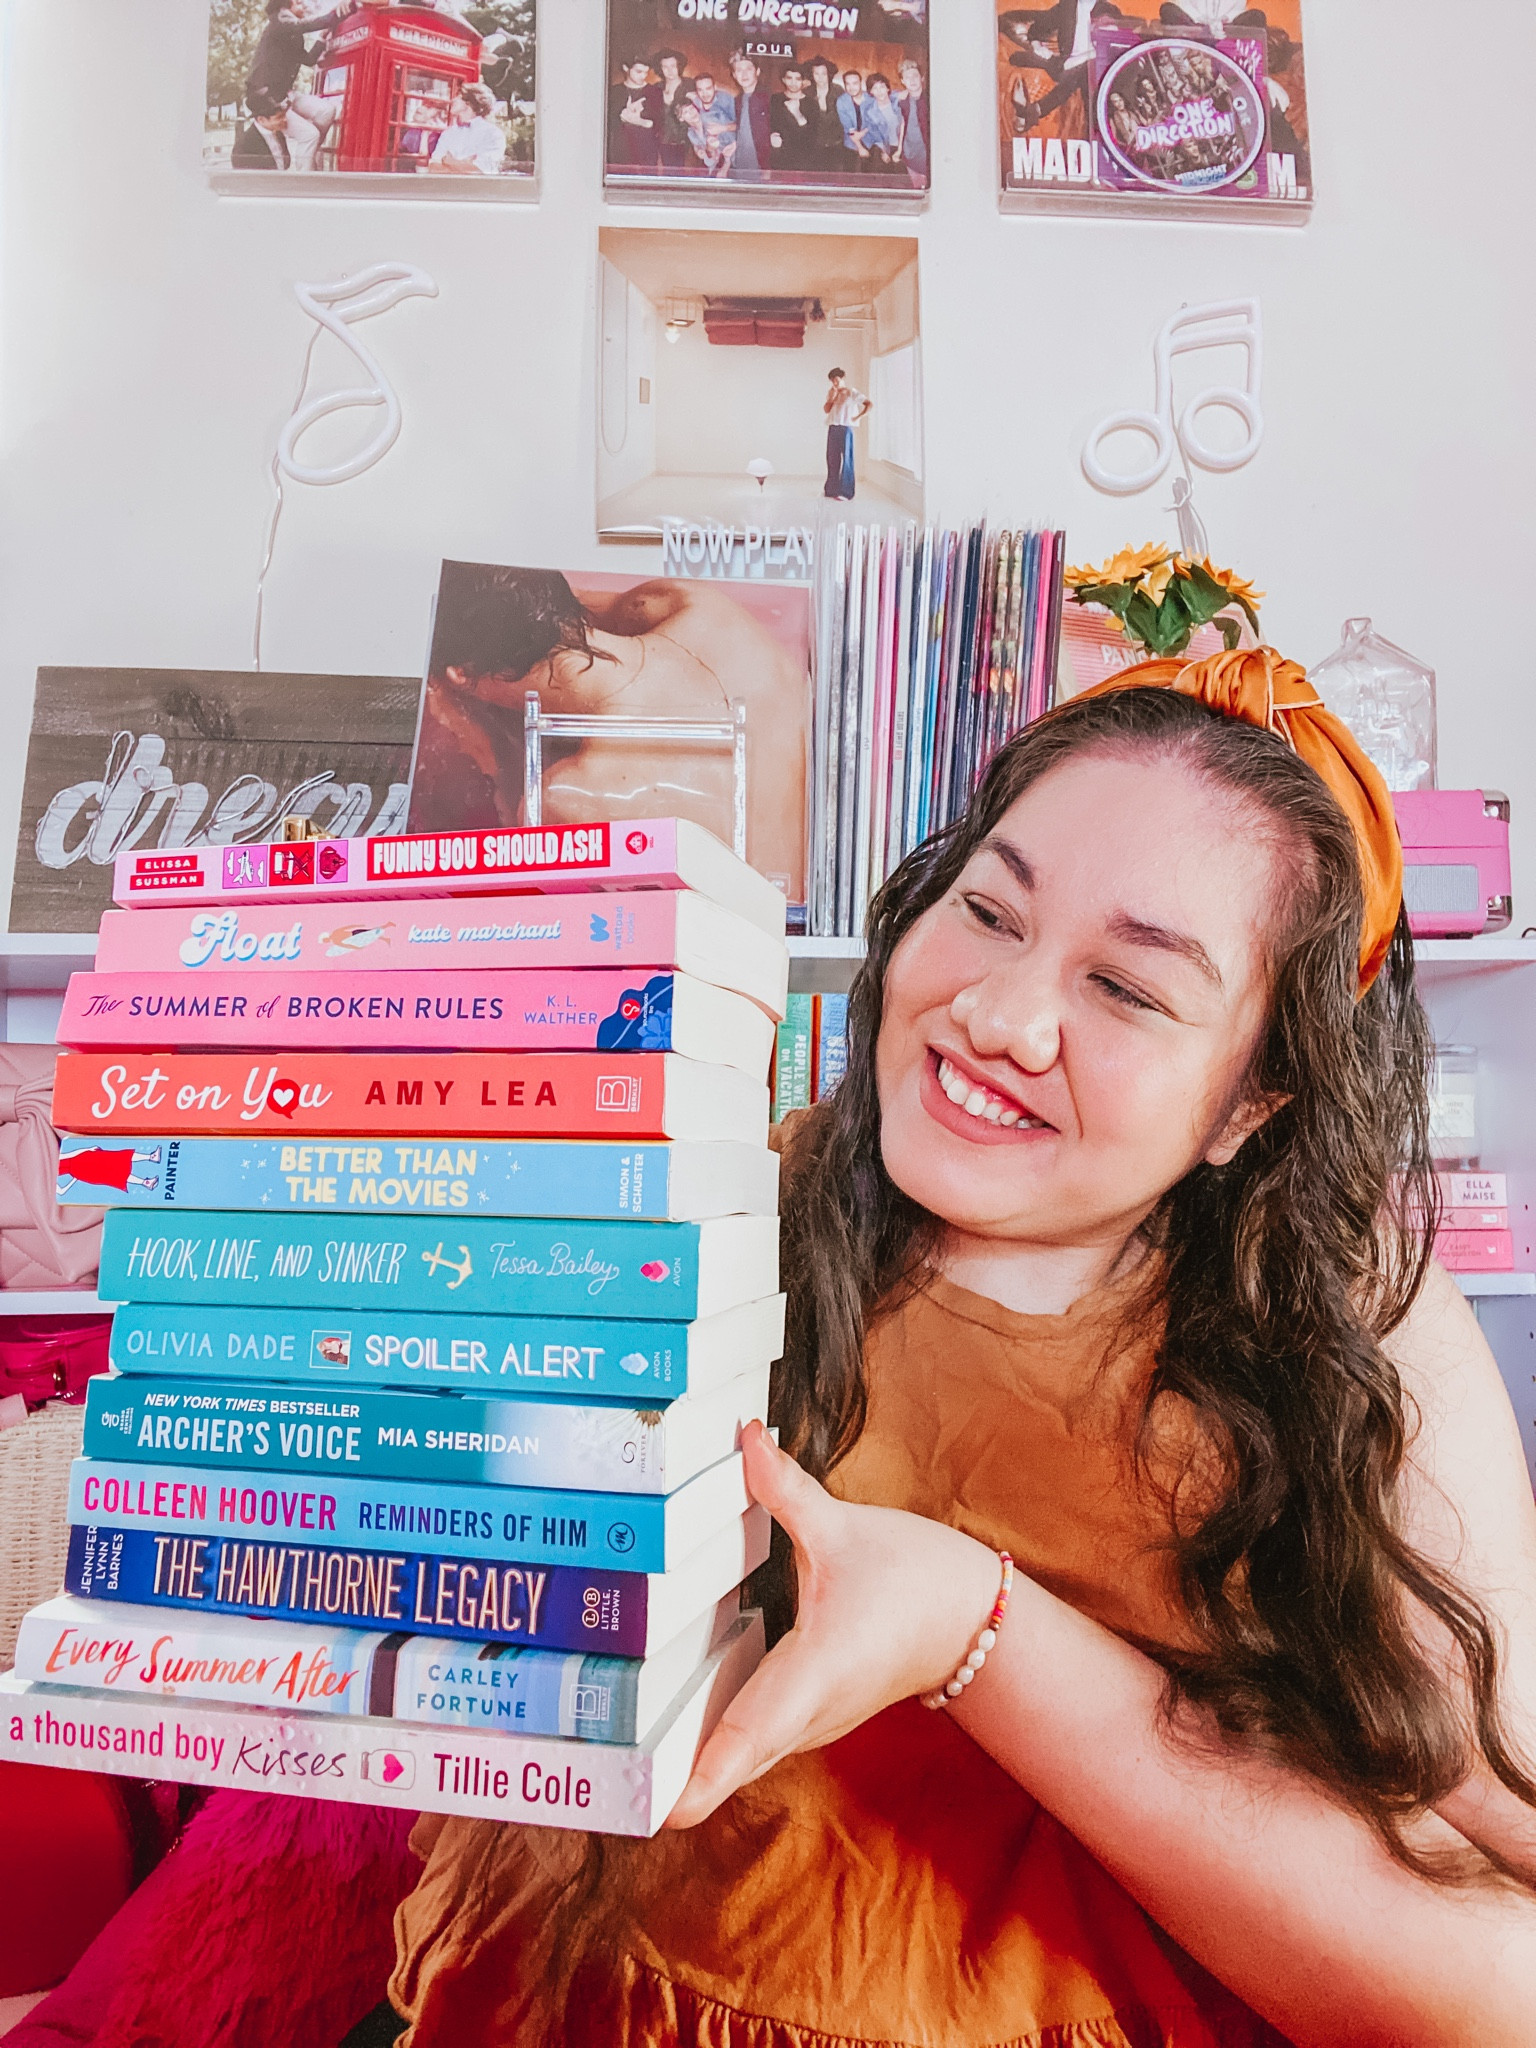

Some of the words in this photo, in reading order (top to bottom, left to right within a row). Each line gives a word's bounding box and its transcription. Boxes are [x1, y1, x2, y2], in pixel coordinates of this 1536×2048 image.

[677, 0, 728, 20] ONE
[738, 0, 859, 32] DIRECTION
[746, 43, 793, 55] FOUR
[1173, 98, 1214, 124] ONE
[1136, 112, 1234, 149] DIRECTION
[1012, 137, 1098, 184] MAD
[662, 522, 735, 563] NOW
[36, 730, 408, 869] drea
[144, 858, 191, 870] ELISSA
[373, 838, 435, 875] FUNNY
[439, 836, 478, 872] YOU
[483, 830, 558, 868] SHOULD
[561, 828, 603, 862] ASK
[135, 874, 198, 887] SUSSMAN
[179, 910, 303, 967] Float
[408, 923, 452, 943] kate
[457, 919, 561, 942] marchant
[81, 994, 125, 1017] The
[128, 995, 248, 1018] SUMMER
[255, 995, 282, 1019] of
[287, 996, 404, 1020] BROKEN
[414, 997, 504, 1021] RULES
[523, 1011, 599, 1025] WALTHER
[546, 995, 561, 1008] K.
[566, 995, 577, 1008] L.
[793, 1034, 807, 1079] PEOPLE
[91, 1064, 170, 1119] Set
[176, 1084, 231, 1110] on
[364, 1080, 455, 1106] AMY
[480, 1081, 558, 1106] LEA
[630, 1077, 638, 1112] BERKLEY
[164, 1141, 180, 1201] PAINTER
[279, 1146, 382, 1174] BETTER
[395, 1148, 477, 1175] THAN
[621, 1156, 630, 1166] &
[285, 1176, 337, 1203] THE
[348, 1178, 469, 1207] MOVIES
[619, 1173, 630, 1209] SIMON
[632, 1153, 644, 1213] SCHUSTER
[1462, 1192, 1496, 1201] MAISE
[1465, 1180, 1492, 1189] ELLA
[126, 1237, 201, 1281] HOOK,
[203, 1239, 261, 1283] LINE,
[269, 1245, 313, 1277] AND
[318, 1241, 407, 1284] SINKER
[490, 1240, 545, 1279] Tessa
[545, 1242, 620, 1296] Bailey
[673, 1257, 681, 1286] AVON
[127, 1330, 214, 1358] OLIVIA
[227, 1334, 295, 1361] DADE
[365, 1335, 491, 1374] SPOILER
[500, 1343, 604, 1380] ALERT
[653, 1351, 661, 1379] AVON
[664, 1349, 672, 1382] BOOKS
[144, 1393, 180, 1407] NEW
[183, 1395, 220, 1410] YORK
[225, 1398, 266, 1412] TIMES
[270, 1400, 360, 1418] BESTSELLER
[279, 1423, 361, 1461] VOICE
[377, 1427, 418, 1448] MIA
[424, 1430, 539, 1455] SHERIDAN
[84, 1476, 207, 1520] COLLEEN
[218, 1487, 336, 1531] HOOVER
[359, 1502, 493, 1540] REMINDERS
[503, 1514, 532, 1542] OF
[542, 1517, 587, 1547] HIM
[80, 1525, 98, 1594] JENNIFER
[95, 1541, 109, 1580] LYNN
[107, 1533, 124, 1590] BARNES
[153, 1537, 209, 1599] THE
[216, 1543, 406, 1621] HAWTHORNE
[414, 1561, 547, 1635] LEGACY
[611, 1590, 620, 1631] BROWN
[45, 1628, 140, 1684] Every
[139, 1635, 281, 1684] Summer
[272, 1645, 360, 1703] After
[428, 1664, 519, 1689] CARLEY
[416, 1693, 526, 1719] FORTUNE
[9, 1716, 24, 1741] a
[34, 1710, 165, 1757] thousand
[175, 1724, 224, 1772] boy
[232, 1736, 348, 1778] Kisses
[433, 1752, 509, 1799] Tillie
[521, 1762, 592, 1808] Cole
